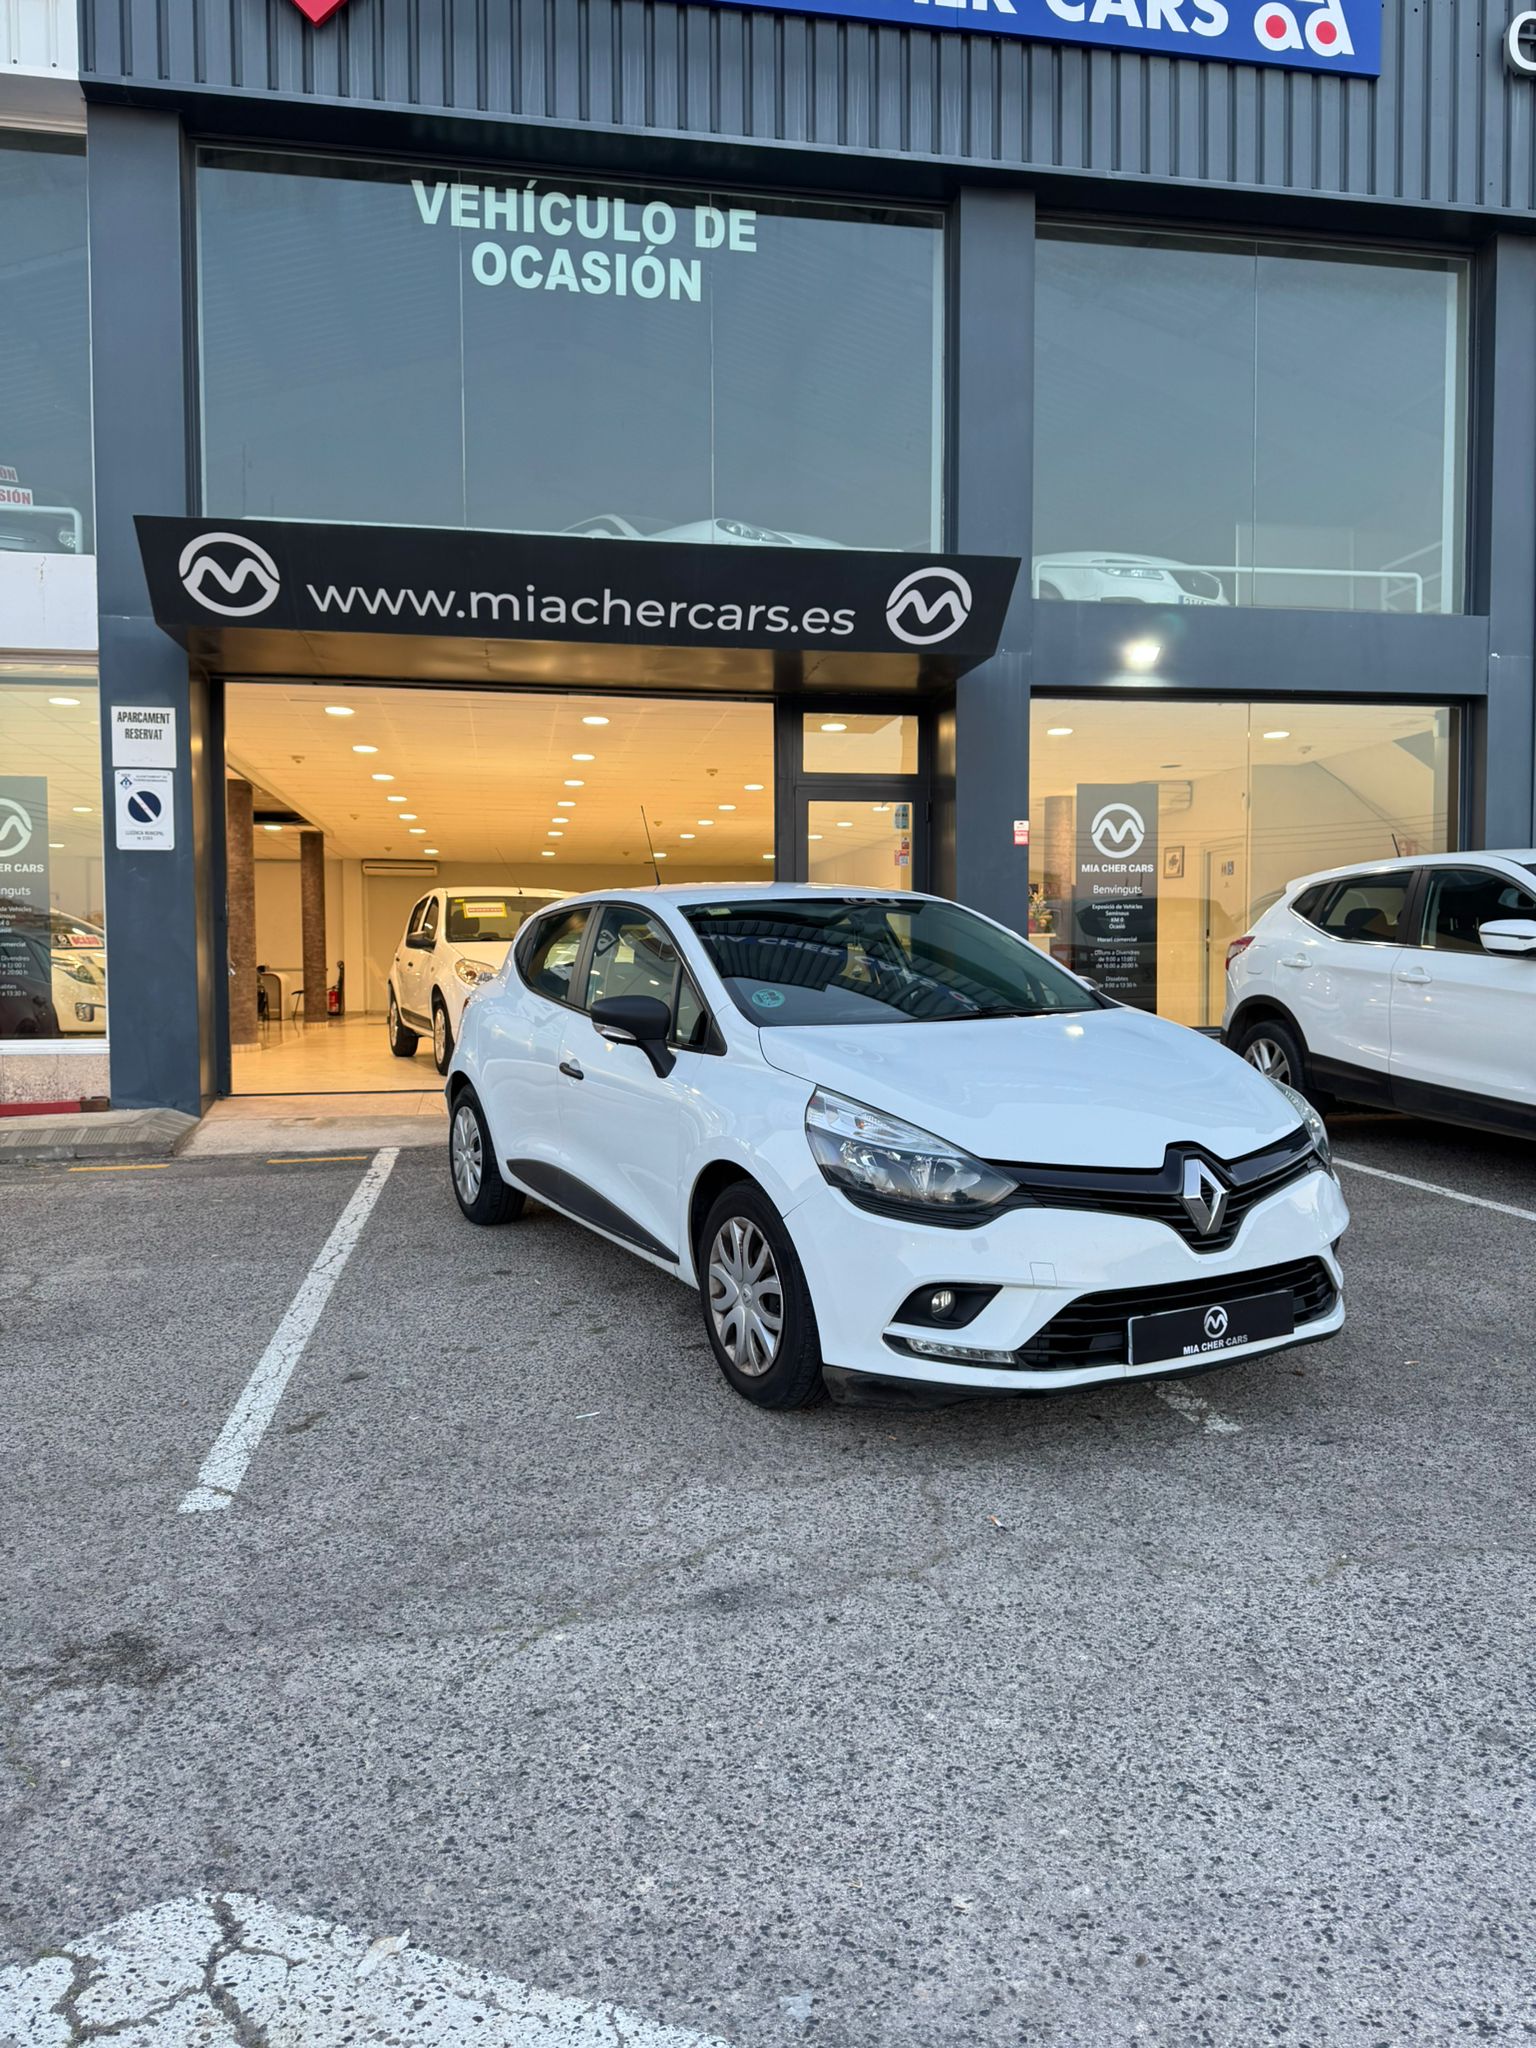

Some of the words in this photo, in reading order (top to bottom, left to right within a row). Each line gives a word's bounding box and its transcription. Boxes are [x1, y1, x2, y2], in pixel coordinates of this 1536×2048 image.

[411, 180, 677, 245] VEHÍCULO
[694, 205, 758, 252] DE
[471, 243, 701, 302] OCASIÓN
[306, 584, 856, 636] www.miachercars.es
[117, 711, 171, 724] APARCAMENT
[124, 728, 163, 741] RESERVAT
[14, 863, 45, 873] CARS
[1081, 864, 1100, 873] MIA
[1101, 864, 1127, 873] CHER
[1128, 864, 1154, 873] CARS
[1093, 885, 1143, 896] Benvinguts
[1183, 1344, 1200, 1355] MIA
[1201, 1340, 1224, 1351] CHER
[1225, 1334, 1249, 1346] CARS
